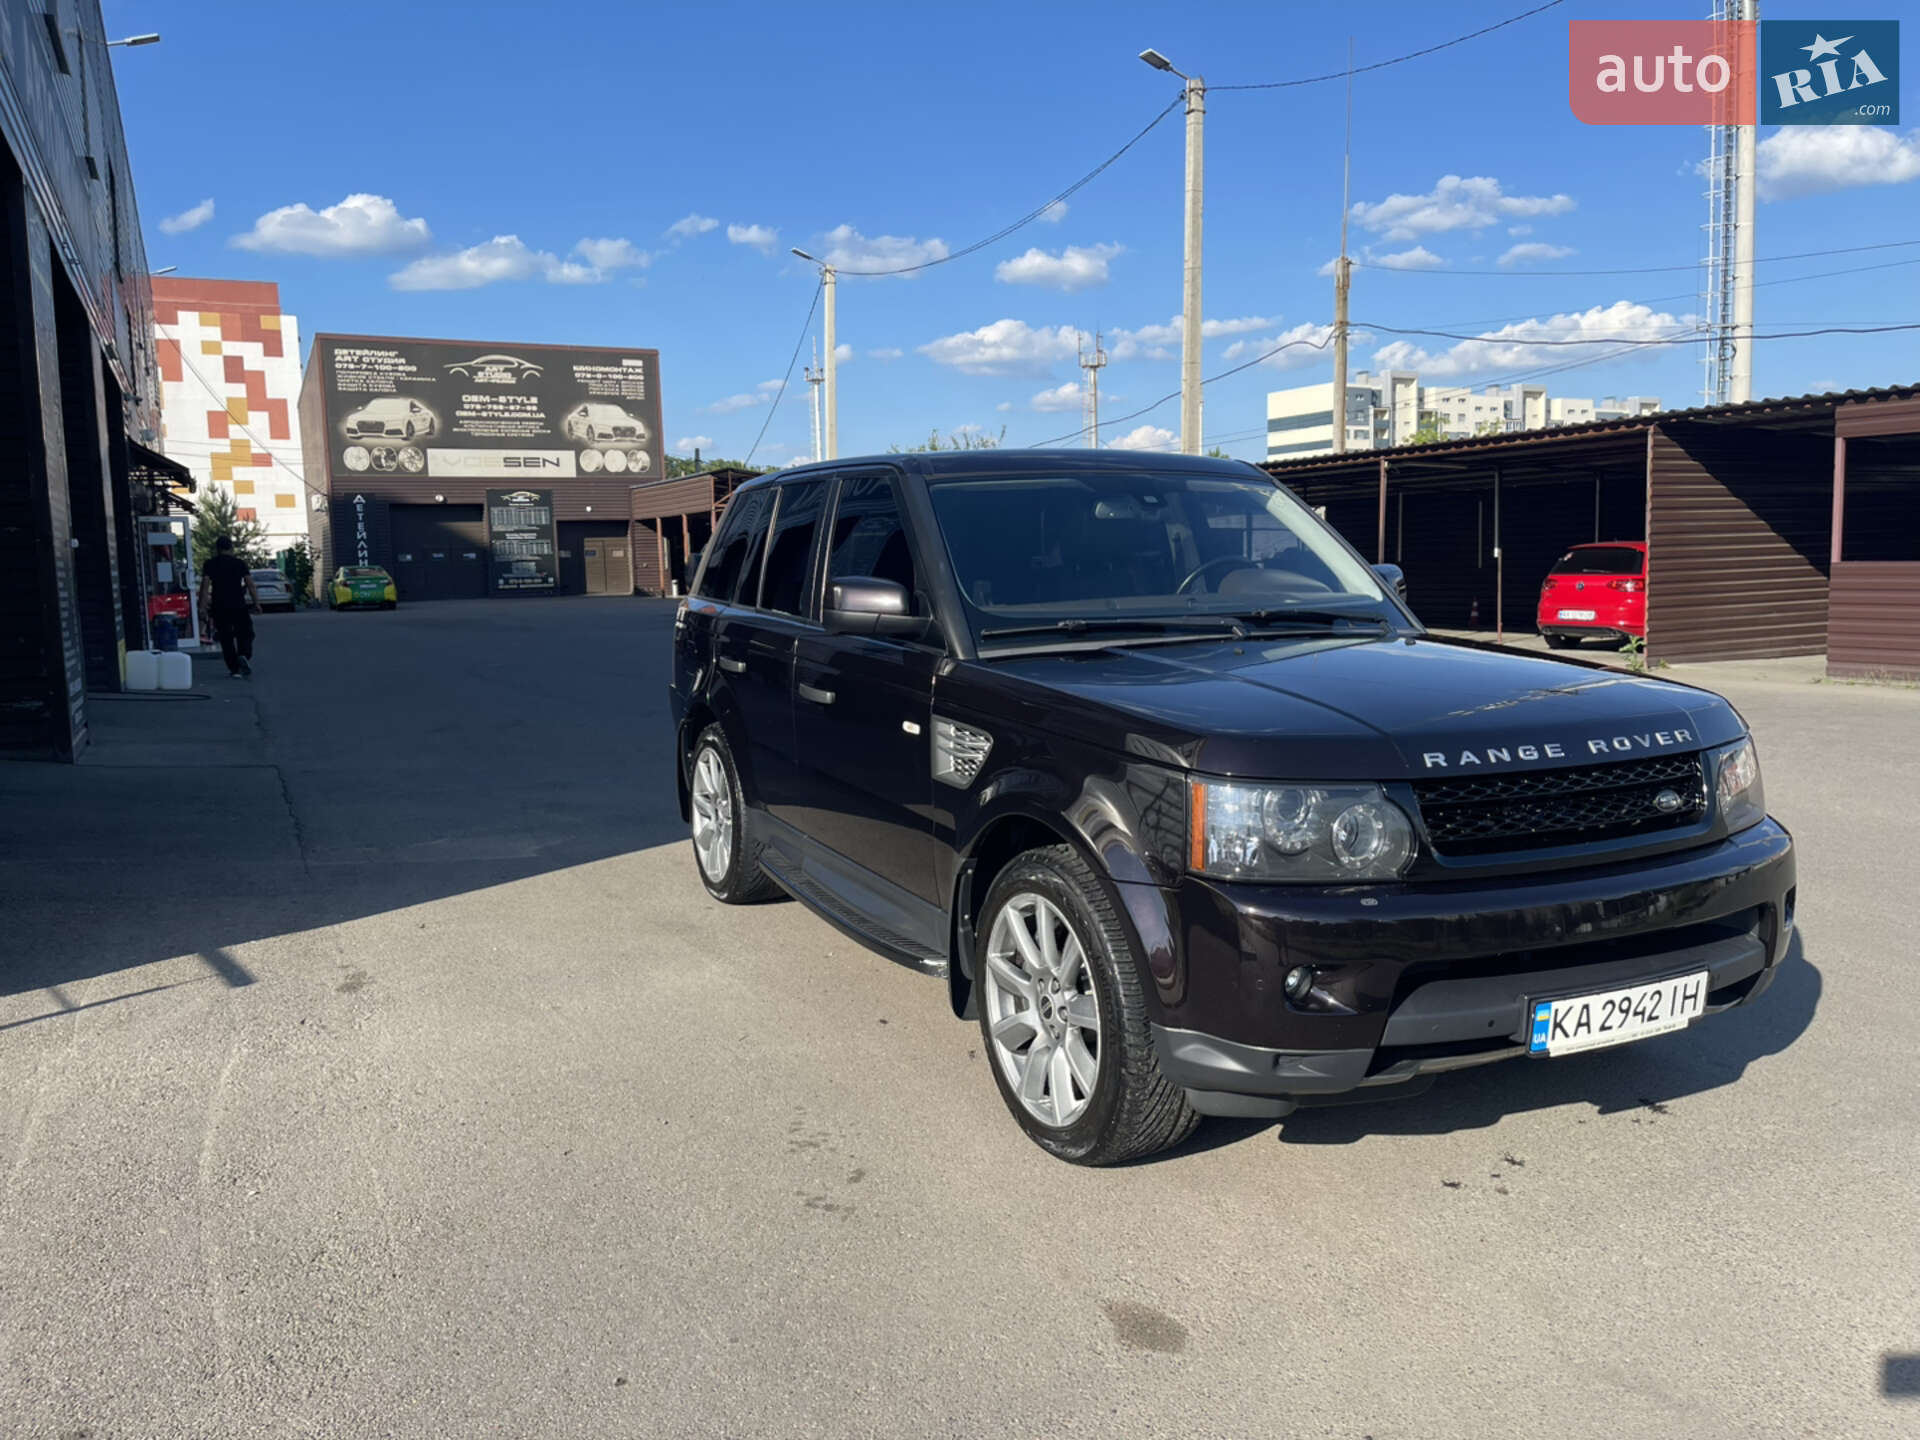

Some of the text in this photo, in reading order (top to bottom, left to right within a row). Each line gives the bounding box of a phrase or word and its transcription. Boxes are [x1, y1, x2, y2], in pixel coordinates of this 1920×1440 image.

[353, 494, 369, 567] ДЕТЕЙЛИН
[1423, 728, 1693, 768] RANGE ROVER
[1551, 980, 1701, 1041] KA 2942 IH
[1532, 1033, 1547, 1045] UA
